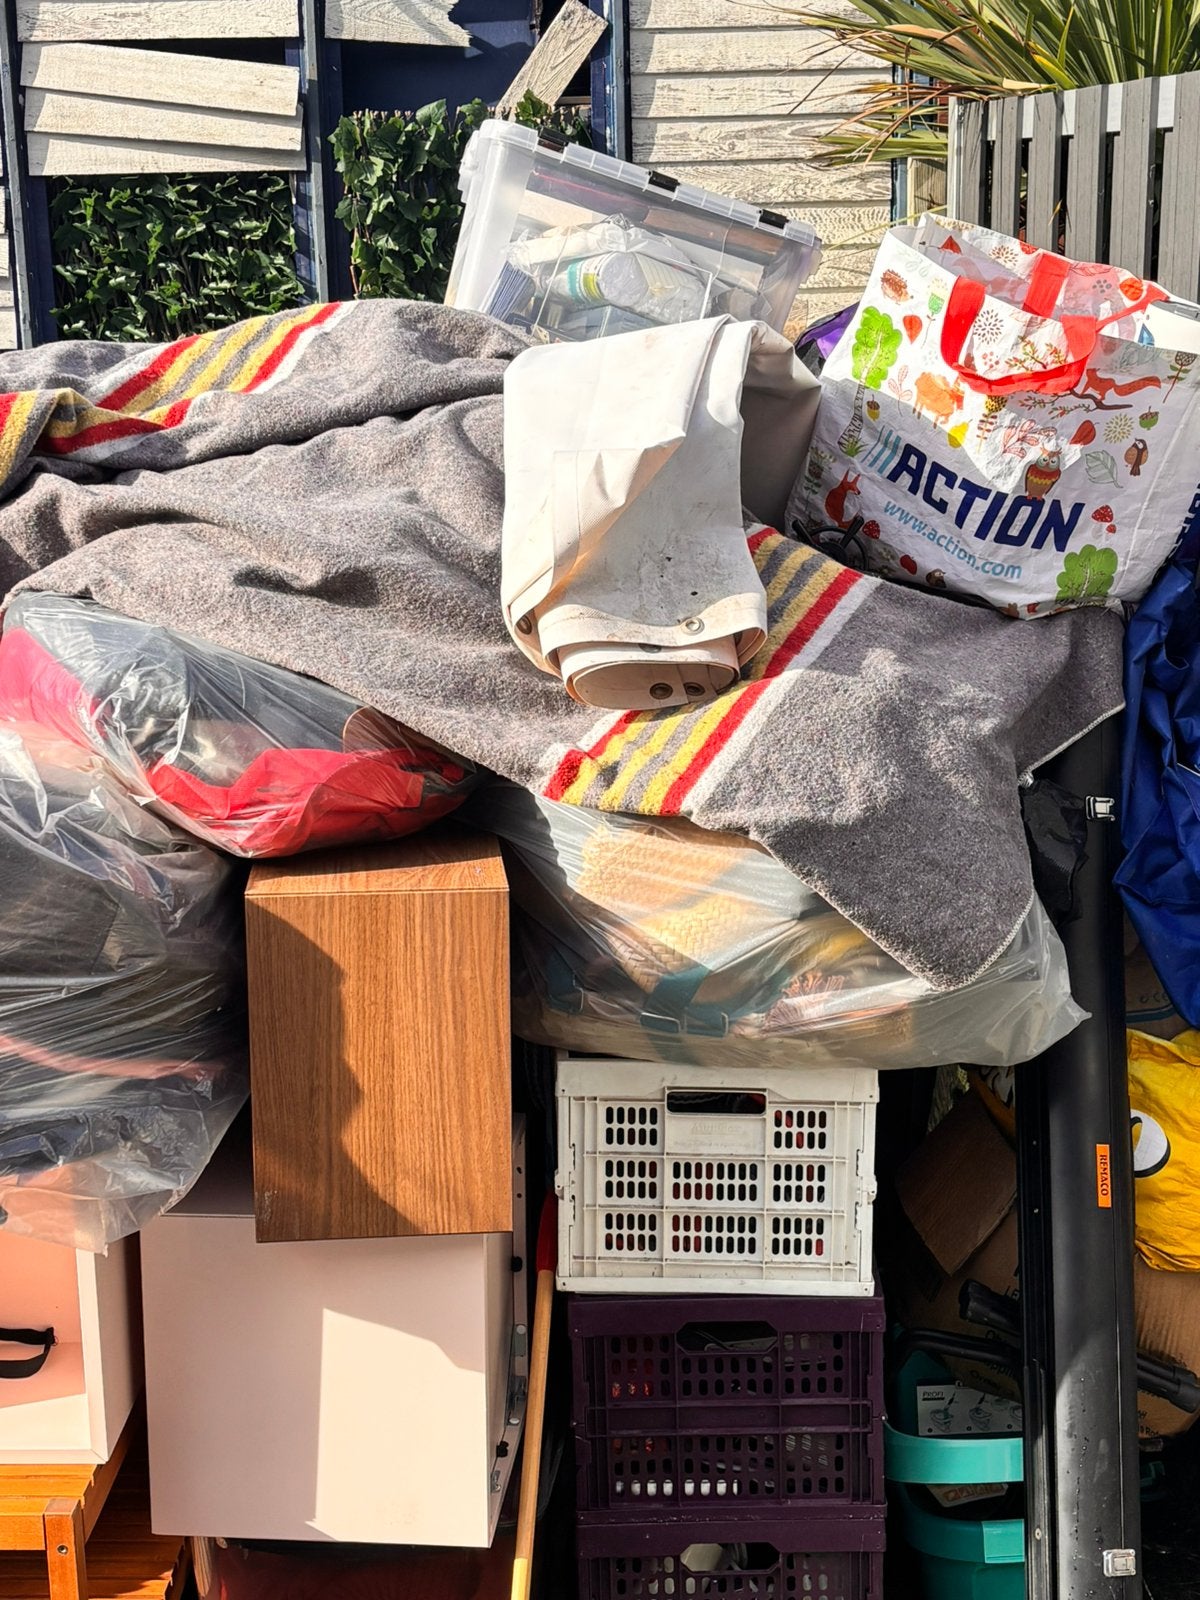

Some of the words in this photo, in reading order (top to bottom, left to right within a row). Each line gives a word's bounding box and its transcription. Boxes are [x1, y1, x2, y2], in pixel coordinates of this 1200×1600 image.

[887, 443, 1086, 553] ACTION
[883, 501, 1022, 579] www.action.com
[1099, 1154, 1110, 1197] REMACO
